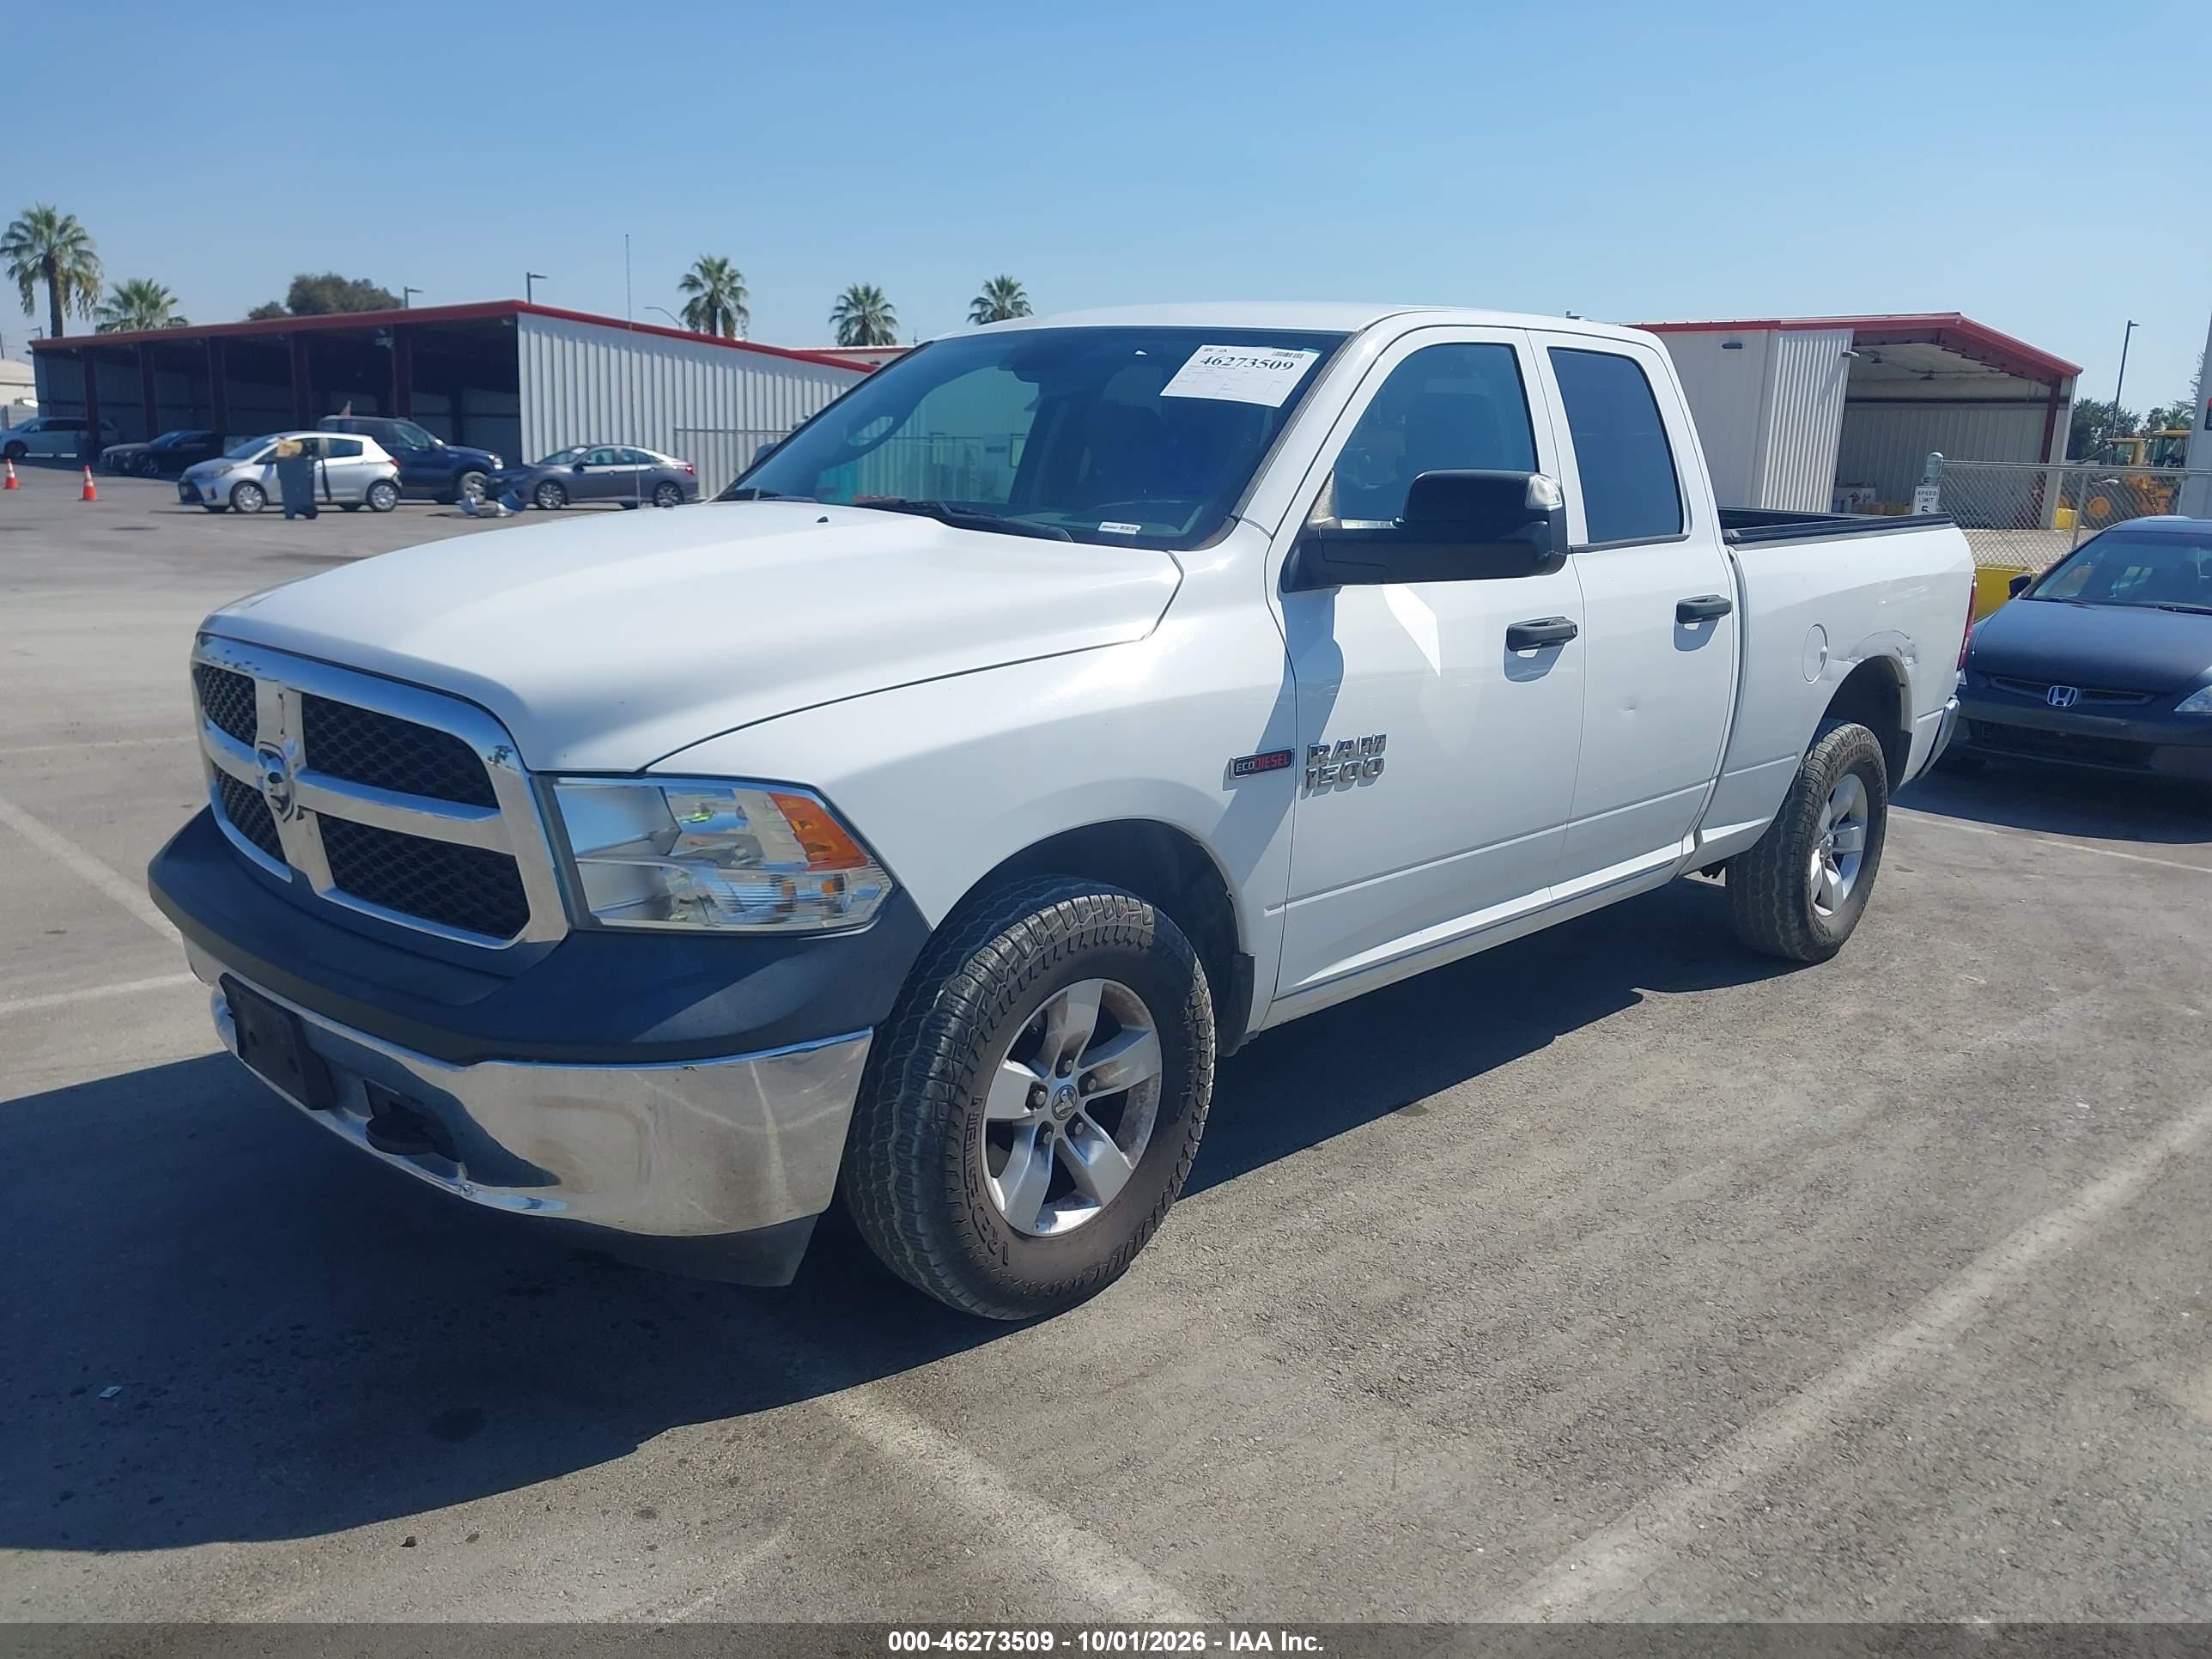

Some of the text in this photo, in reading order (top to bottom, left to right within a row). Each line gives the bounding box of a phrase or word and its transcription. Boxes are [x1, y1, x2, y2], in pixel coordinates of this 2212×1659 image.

[1200, 356, 1294, 371] 46273509
[1306, 733, 1387, 766] RAM
[1236, 753, 1290, 773] ECODIESEL
[1305, 756, 1386, 789] 1500
